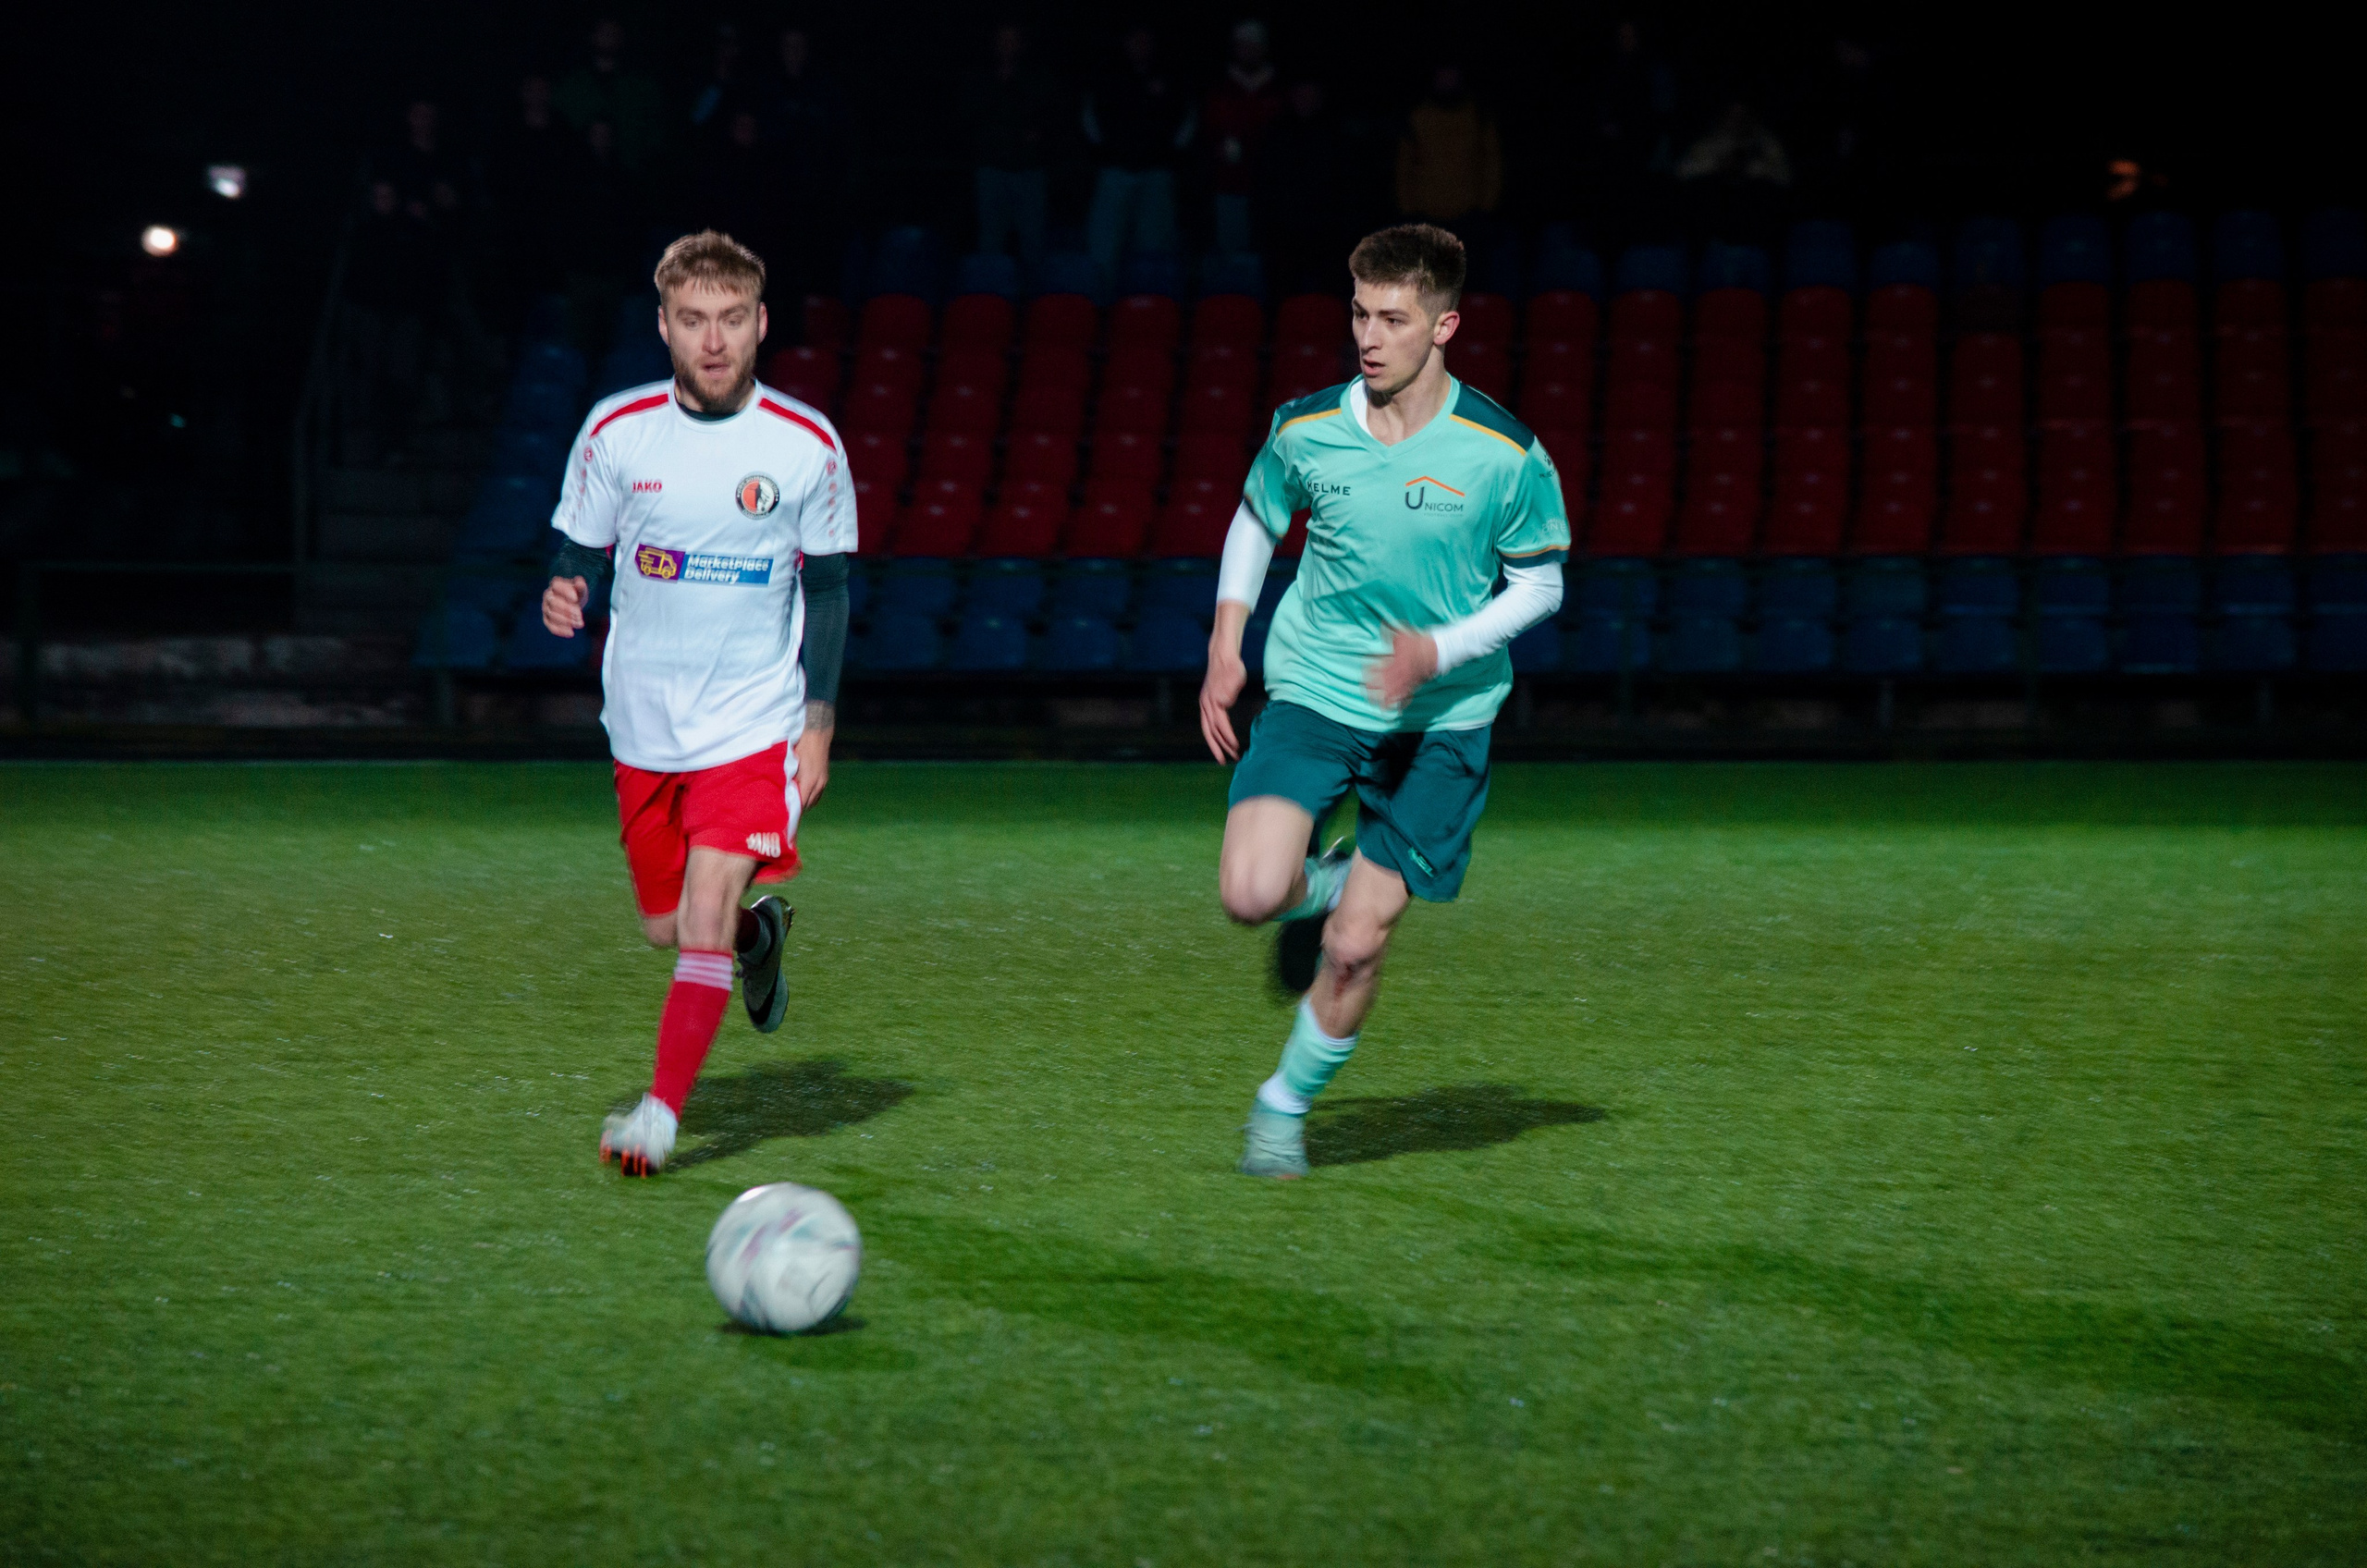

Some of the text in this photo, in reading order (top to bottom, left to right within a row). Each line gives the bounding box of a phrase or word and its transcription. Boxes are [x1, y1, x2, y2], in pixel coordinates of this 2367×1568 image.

[632, 480, 662, 493] JAKO
[1306, 481, 1351, 496] KELME
[687, 555, 769, 571] MarketPlace
[684, 567, 740, 584] Delivery
